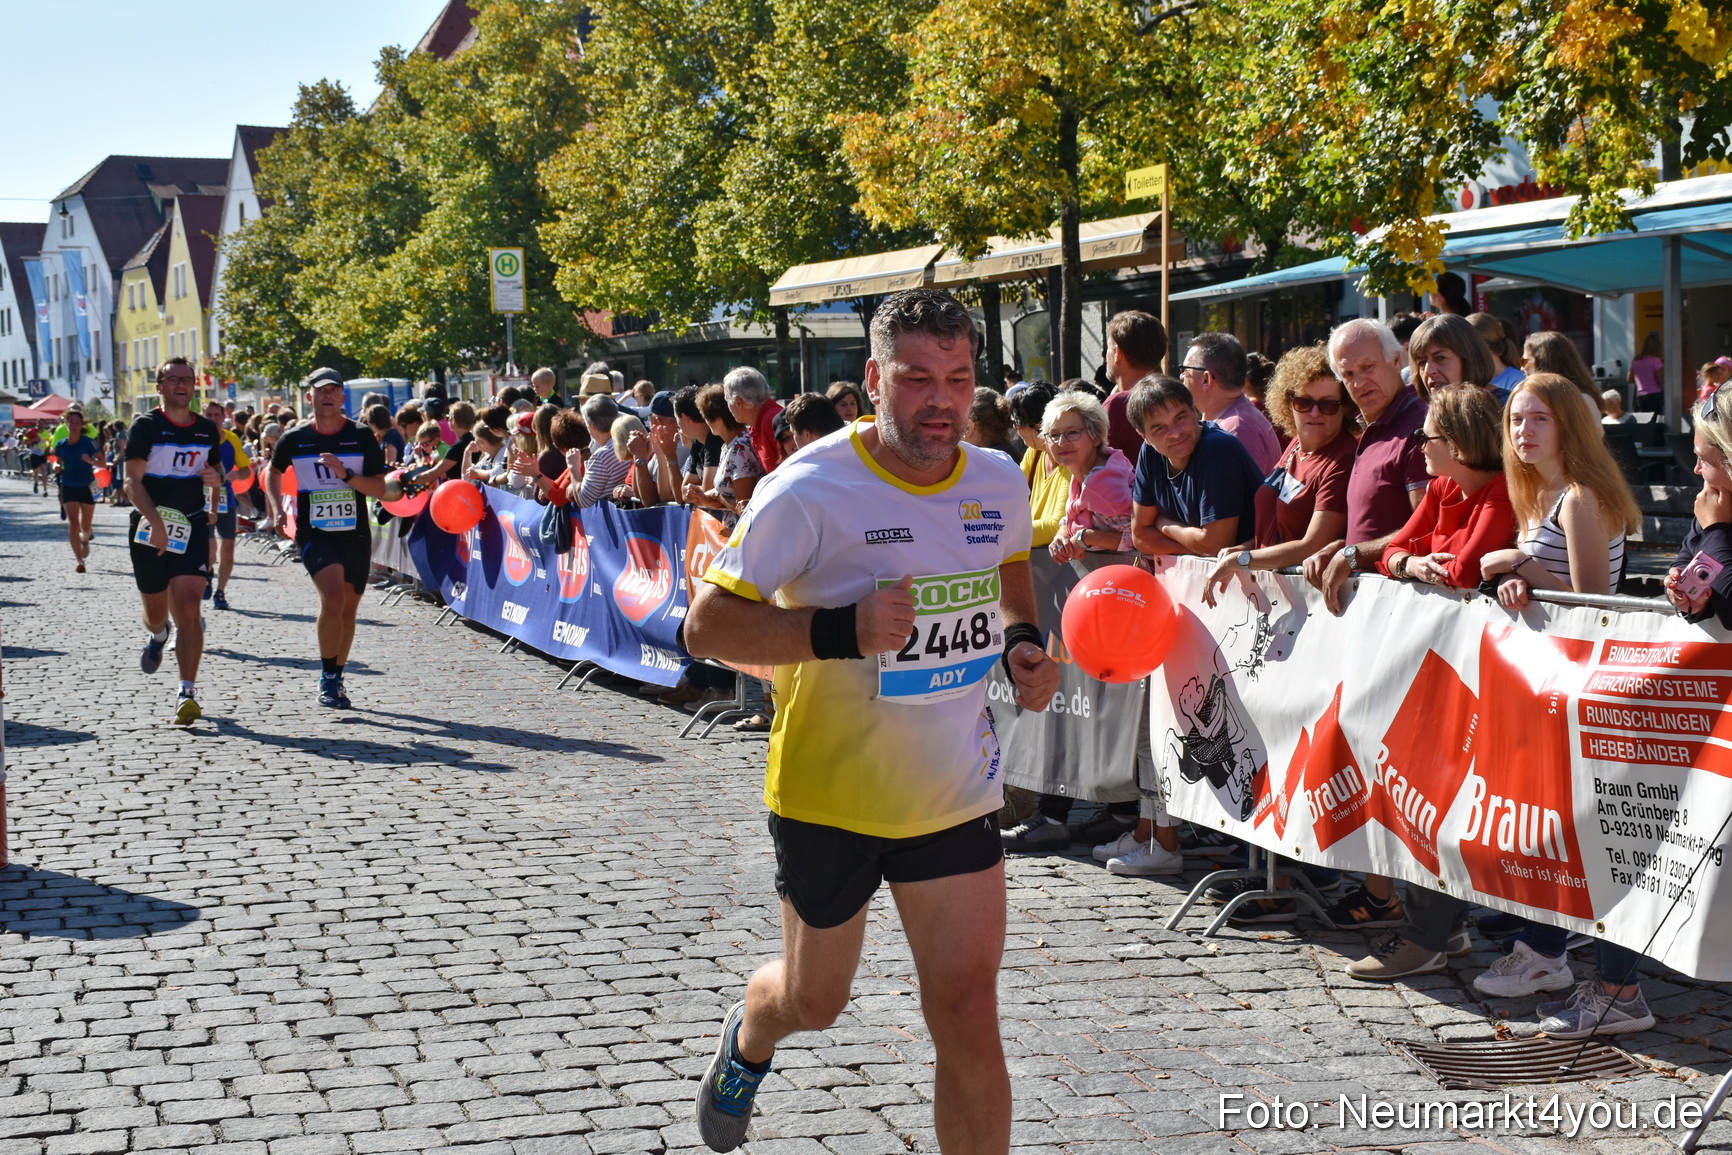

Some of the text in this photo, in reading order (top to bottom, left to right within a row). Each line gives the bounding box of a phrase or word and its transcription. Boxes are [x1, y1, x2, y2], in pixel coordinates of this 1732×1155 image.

[1133, 176, 1163, 190] Toiletten
[501, 258, 514, 271] H
[314, 491, 353, 502] BOCK
[316, 504, 352, 517] 2119
[962, 503, 981, 520] 20
[865, 528, 913, 541] BOCK
[1086, 580, 1147, 604] RÖDL
[896, 612, 992, 662] 2448
[929, 668, 967, 689] ADY
[1591, 674, 1719, 698] VERZURRSYSTEME
[1549, 691, 1559, 714] Seit
[1586, 705, 1711, 732] RUNDSCHLINGEN
[1462, 713, 1479, 753] Seit 1929
[1589, 738, 1691, 763] HEBEBÄNDER
[1304, 765, 1363, 824] Braun
[1374, 744, 1437, 841] Braun
[1594, 777, 1679, 802] Braun GmbH
[1460, 774, 1569, 863] Braun
[1597, 799, 1688, 828] Am Grünberg 8
[1411, 829, 1420, 843] ist
[1600, 819, 1653, 840] D-92318
[1605, 847, 1630, 865] Tel.
[1633, 850, 1662, 872] 09181
[1501, 858, 1587, 889] Sicher ist sicher
[1610, 867, 1633, 886] Fax
[1636, 871, 1660, 894] 09181
